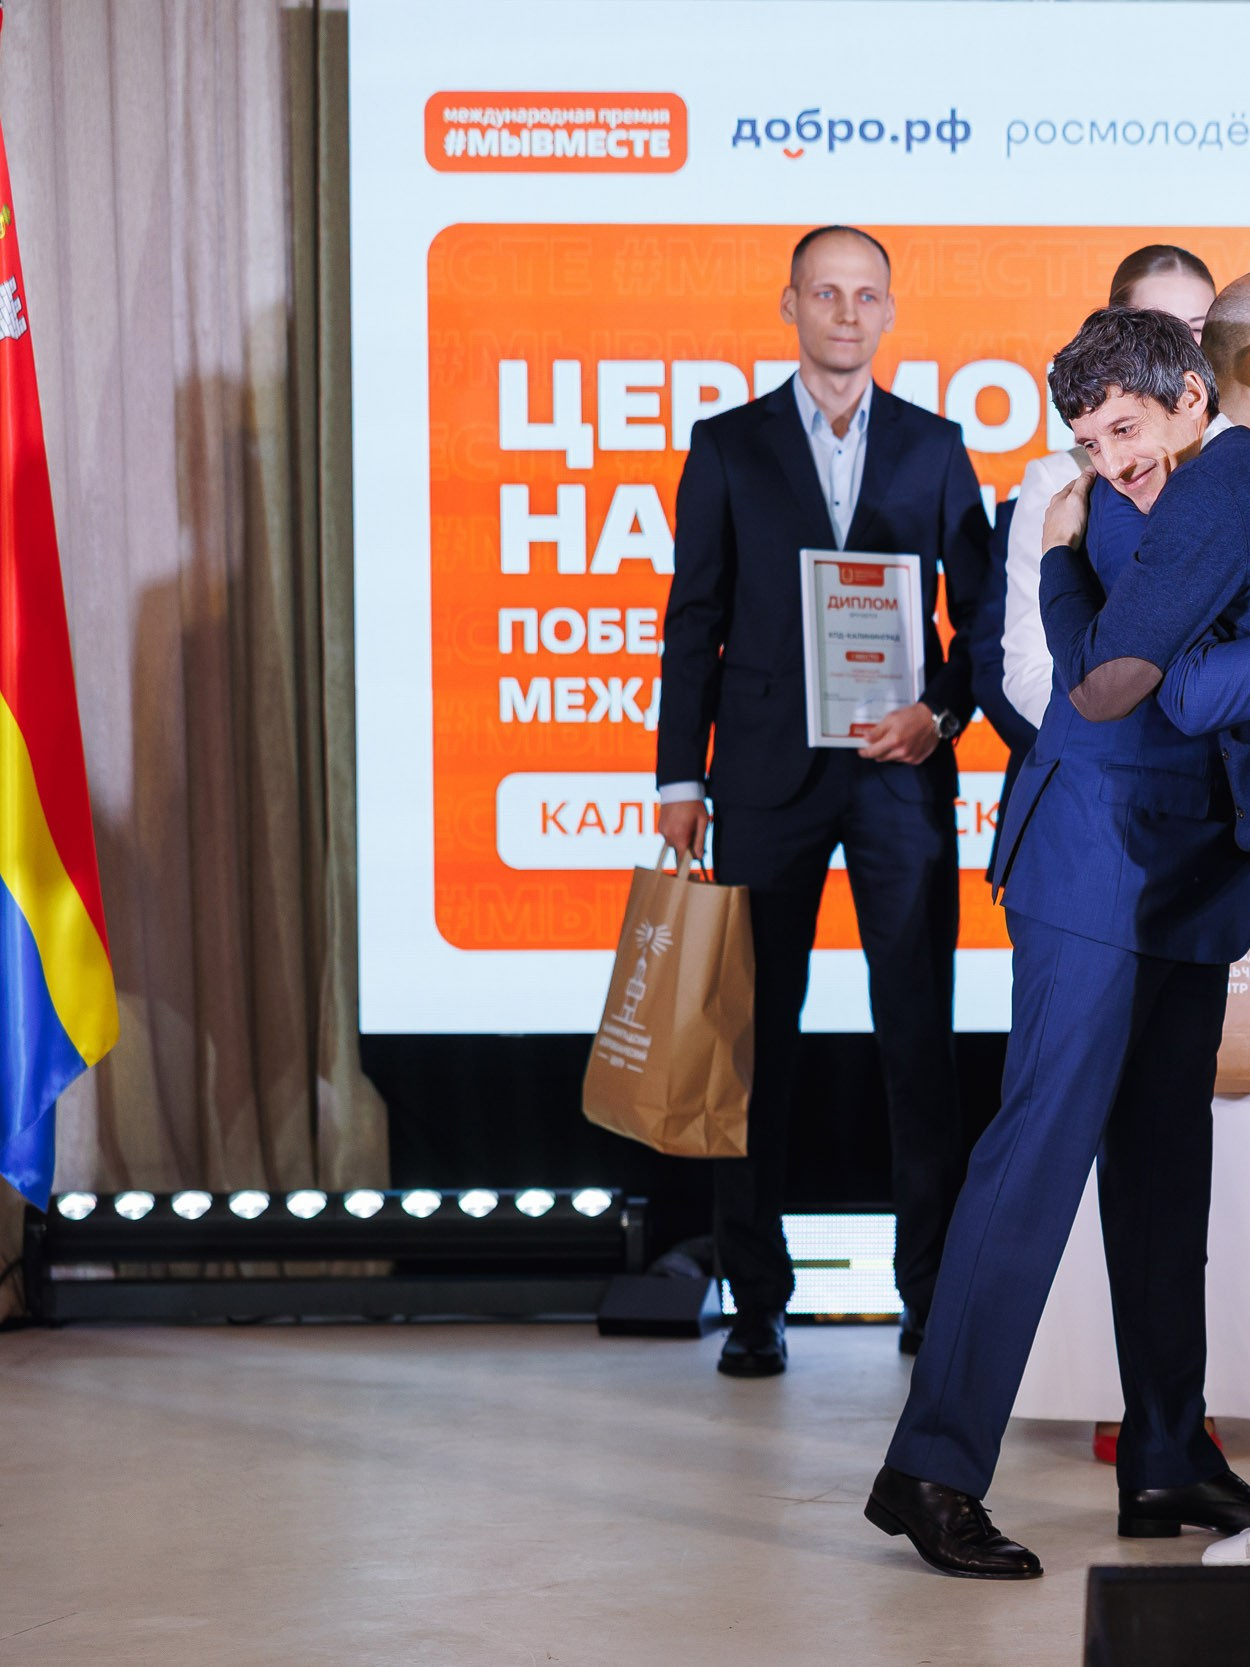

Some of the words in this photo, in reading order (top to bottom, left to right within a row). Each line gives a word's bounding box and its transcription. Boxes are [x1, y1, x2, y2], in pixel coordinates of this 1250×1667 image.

[443, 106, 596, 129] международная
[598, 107, 671, 129] премия
[732, 107, 973, 153] добро.рф
[443, 128, 671, 158] #МЫВМЕСТЕ
[827, 595, 899, 613] ДИПЛОМ
[498, 607, 665, 658] ПОБЕ
[540, 801, 662, 835] КАЛ
